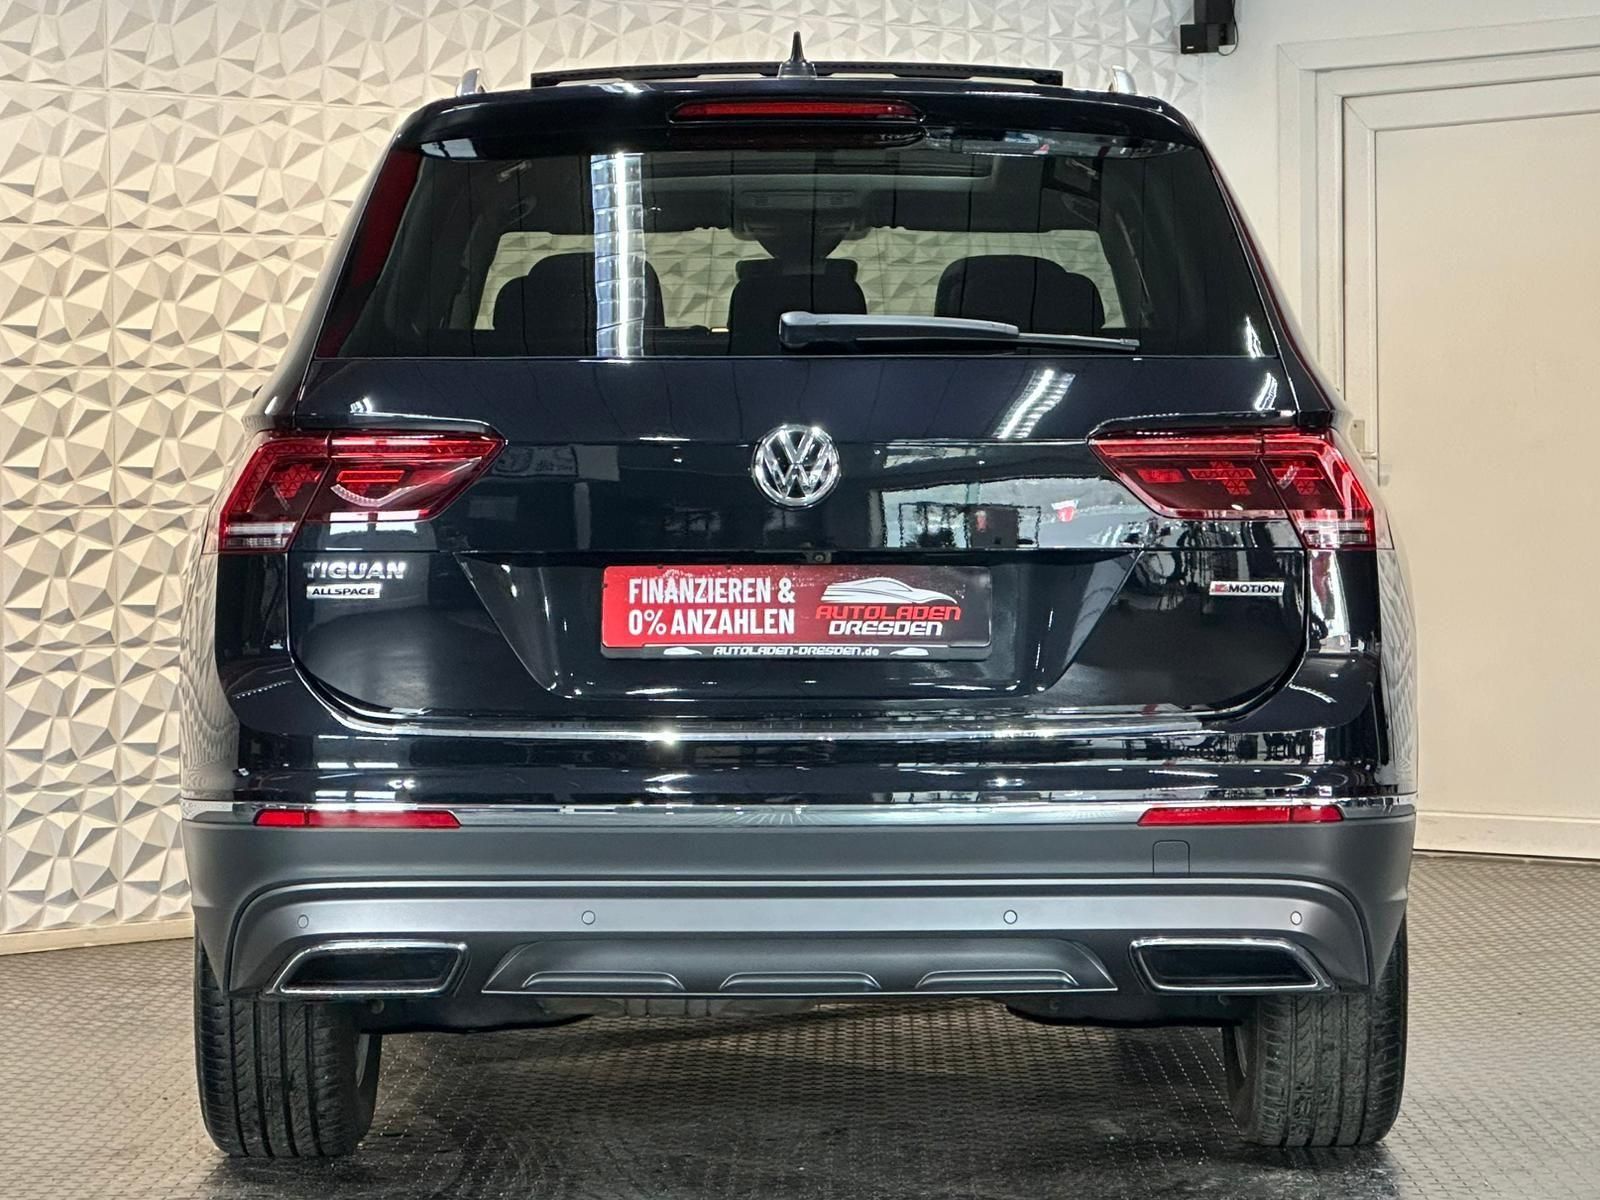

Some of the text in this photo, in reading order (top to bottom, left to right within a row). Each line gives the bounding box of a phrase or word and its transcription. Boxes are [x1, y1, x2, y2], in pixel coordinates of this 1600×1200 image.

[303, 561, 406, 579] TIGUAN
[311, 587, 376, 596] ALLSPACE
[628, 577, 796, 604] FINANZIEREN &
[815, 605, 962, 621] AUTOLADEN
[628, 608, 796, 636] 0% ANZAHLEN
[828, 620, 943, 636] DRESDEN
[713, 646, 880, 657] AUTOLADEN-DRESDEN.de
